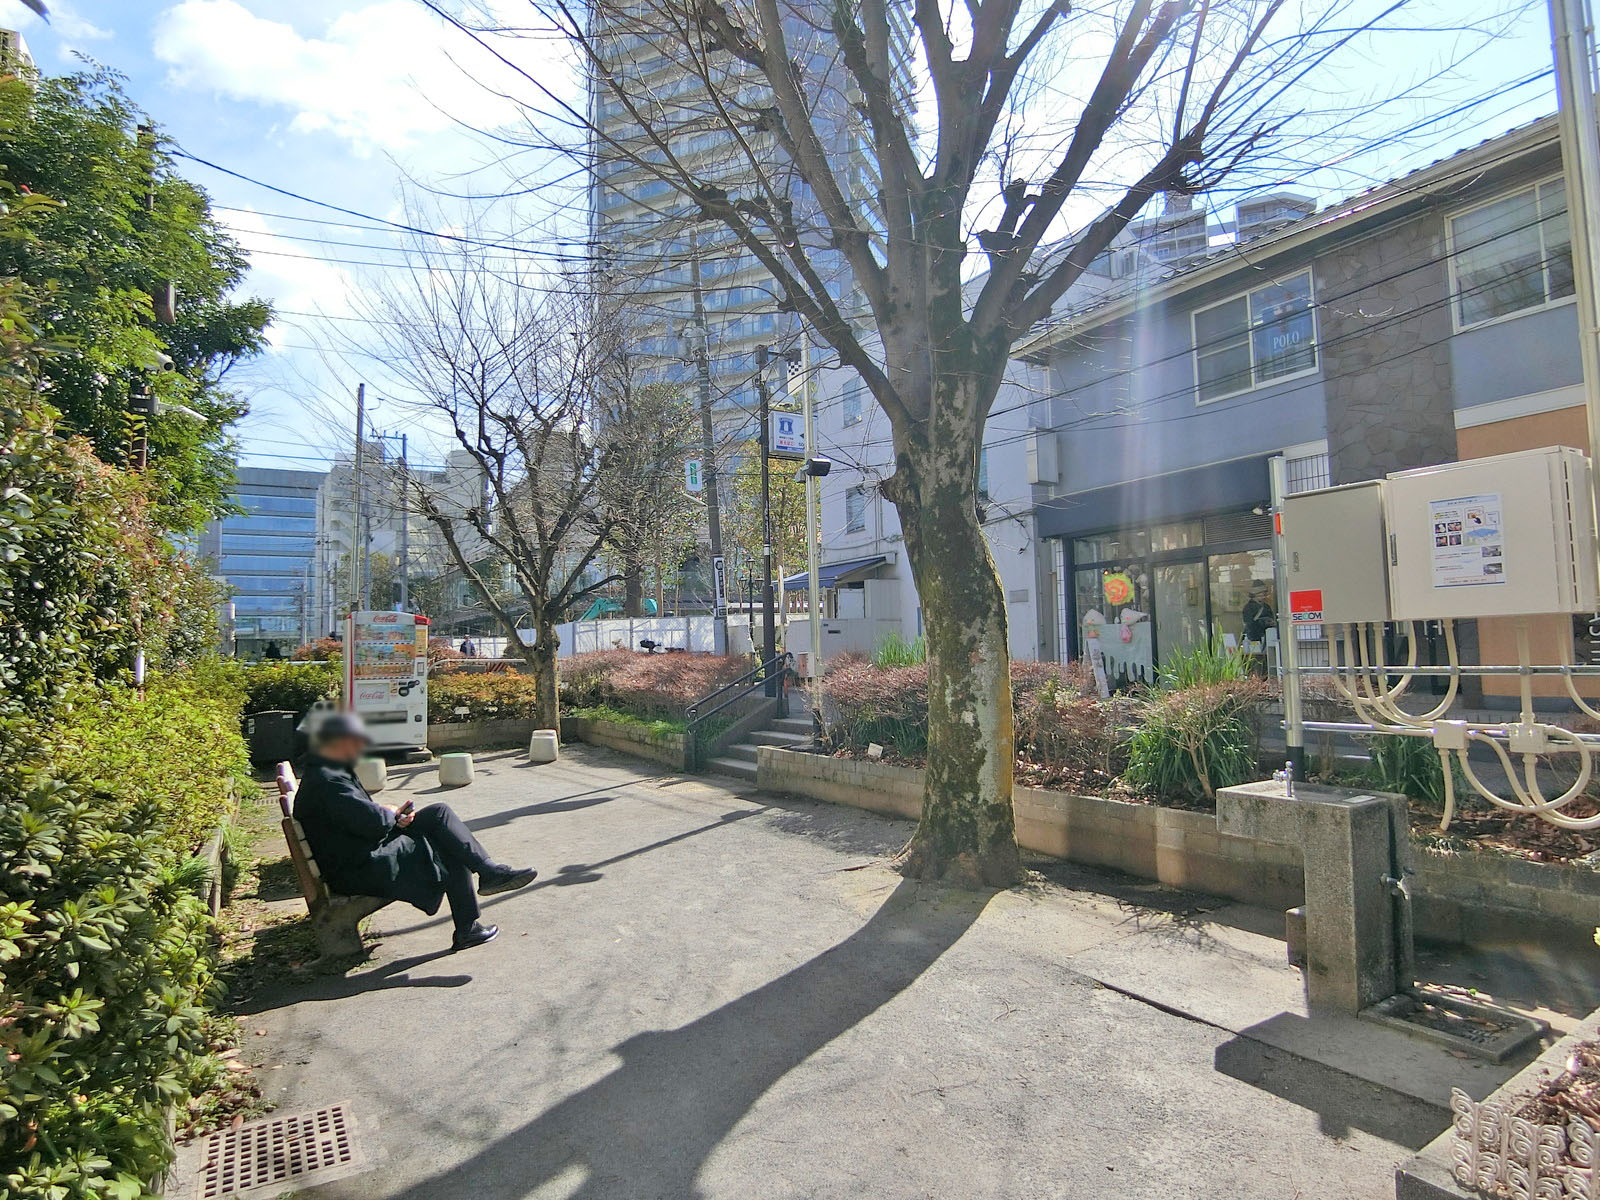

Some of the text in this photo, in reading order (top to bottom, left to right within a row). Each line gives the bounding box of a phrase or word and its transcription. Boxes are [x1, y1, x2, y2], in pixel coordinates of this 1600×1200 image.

[1273, 330, 1300, 350] POLO
[373, 614, 398, 623] Coca-Cola
[1292, 612, 1322, 621] SECOM
[359, 691, 385, 700] Coca-Cola
